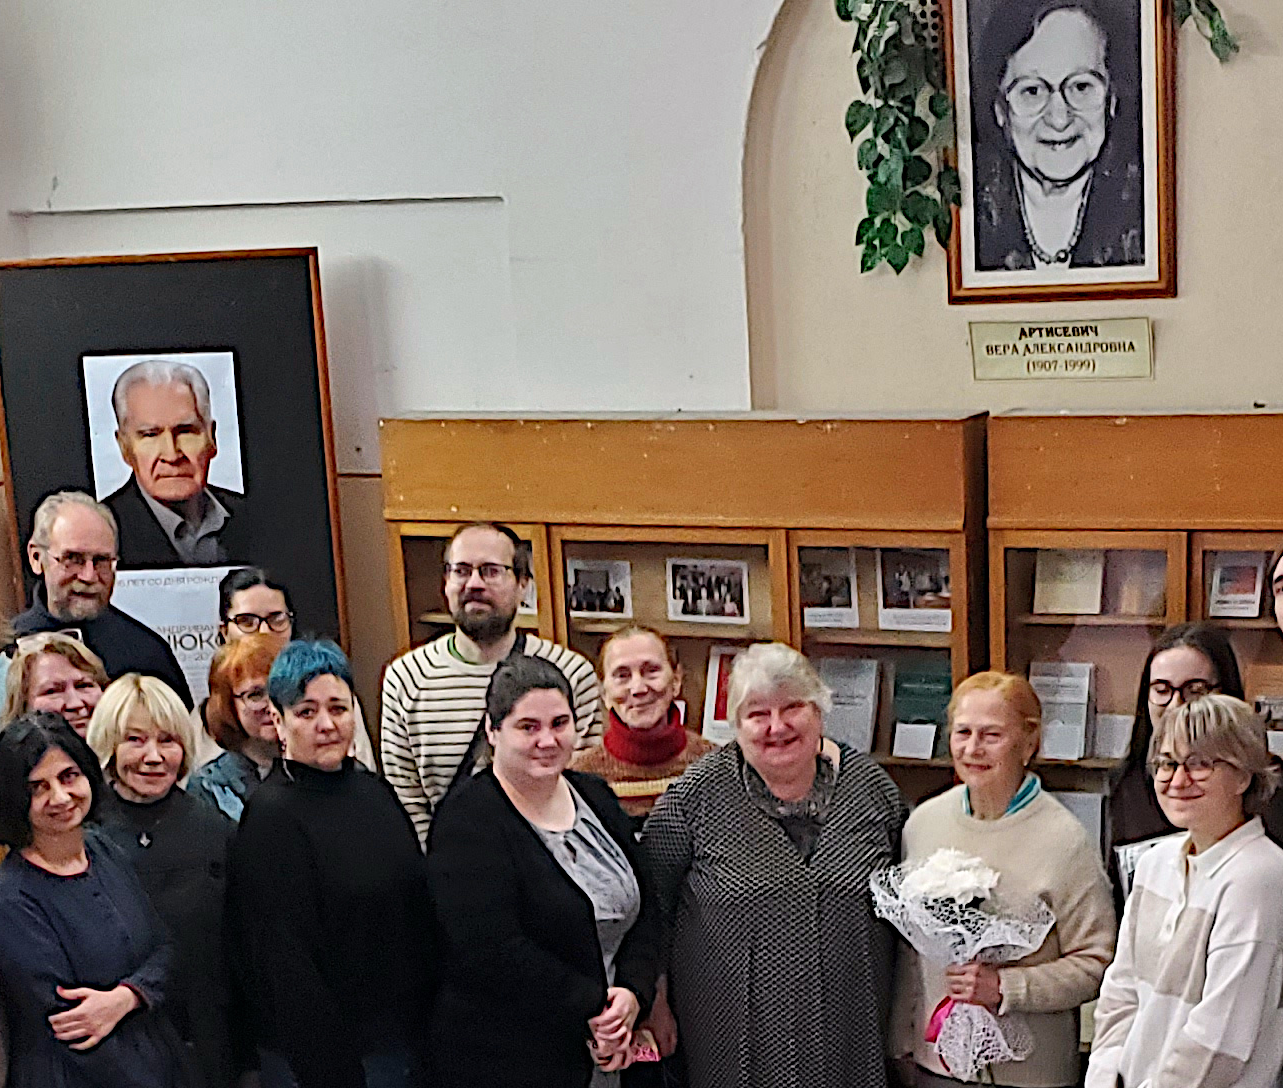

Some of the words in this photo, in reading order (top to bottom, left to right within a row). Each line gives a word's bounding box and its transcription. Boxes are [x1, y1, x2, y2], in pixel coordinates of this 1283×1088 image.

[1018, 325, 1099, 340] АРТИСЕВИЧ
[985, 343, 1019, 356] ВЕРА
[1023, 342, 1136, 357] АЛЕКСАНДРОВНА
[1026, 359, 1096, 374] (1907-1999)
[127, 578, 145, 587] ЛЕТ
[147, 577, 162, 586] СО
[163, 577, 185, 586] ДНЯ
[187, 575, 220, 585] РОЖД
[157, 625, 187, 634] АНДР
